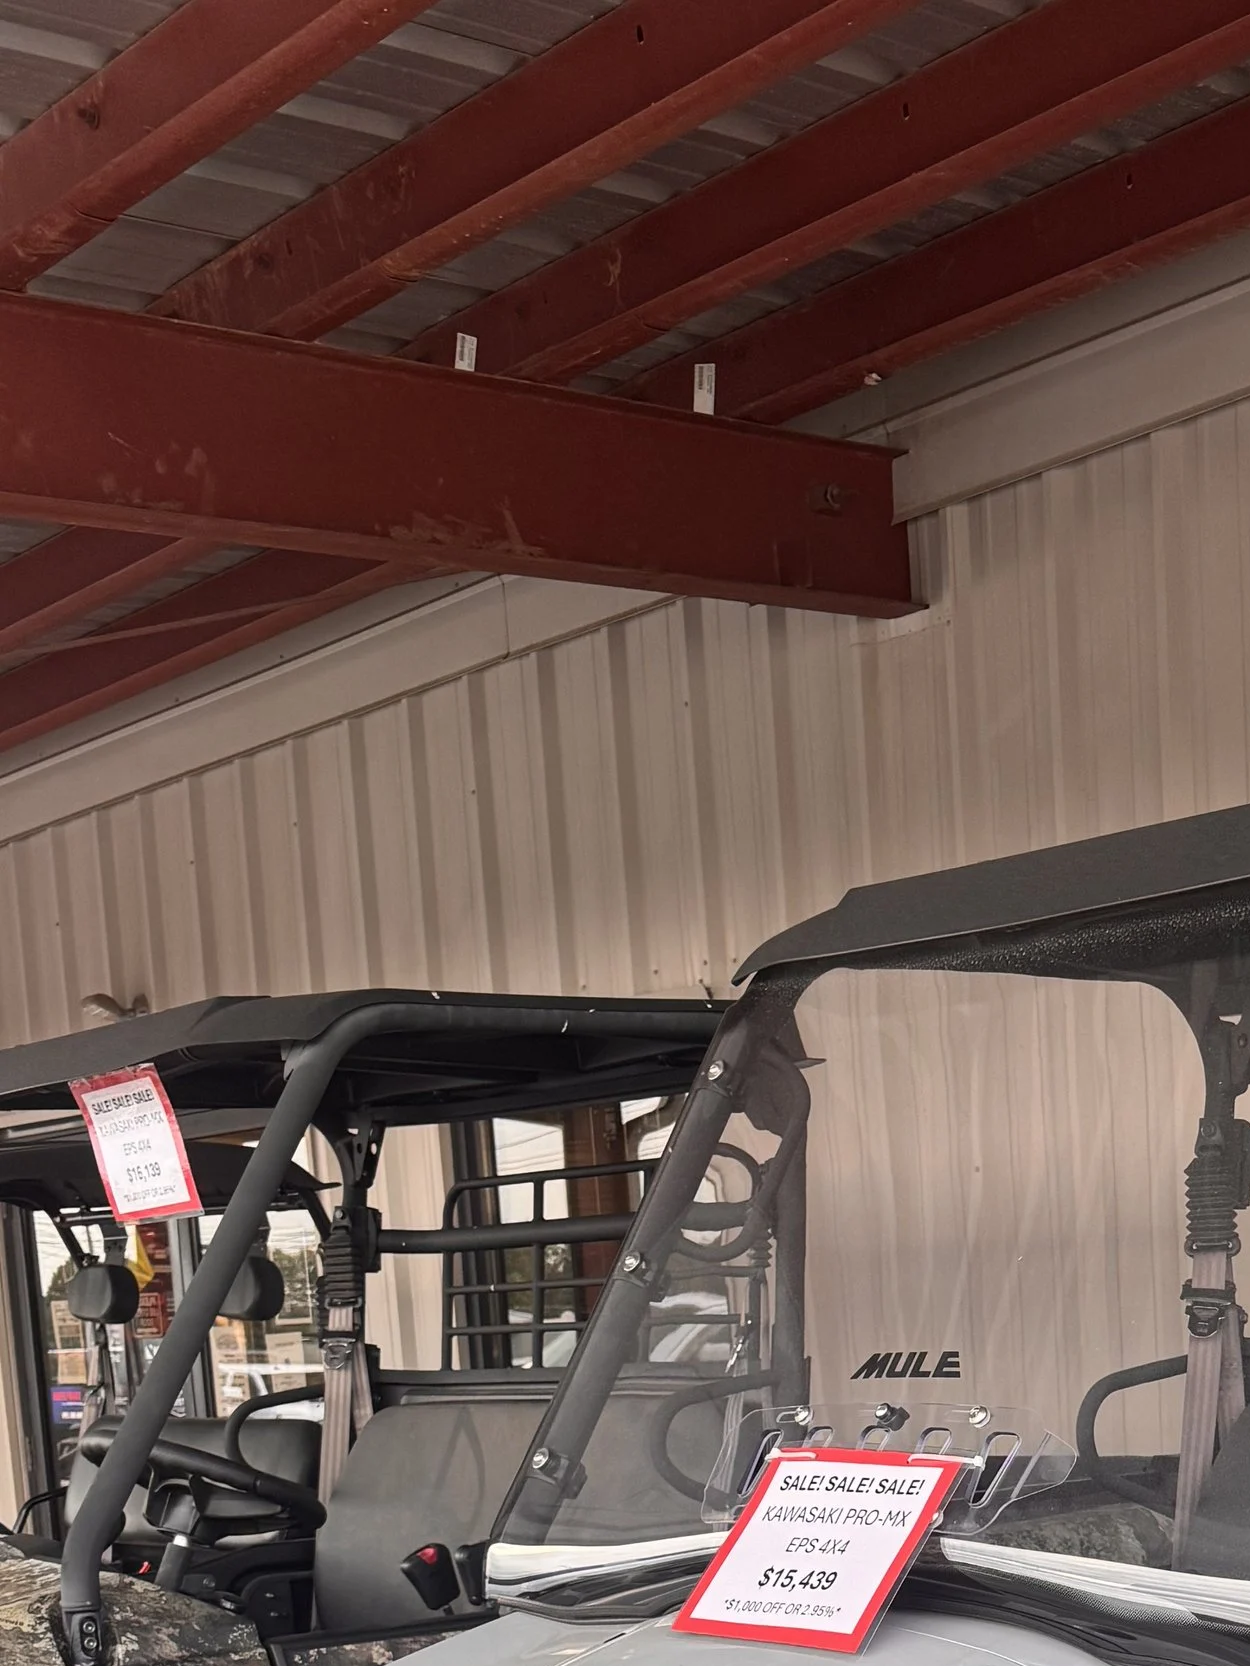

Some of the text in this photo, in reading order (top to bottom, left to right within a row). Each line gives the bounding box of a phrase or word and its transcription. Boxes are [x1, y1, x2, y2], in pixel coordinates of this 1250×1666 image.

[92, 1088, 155, 1115] SALE! SALE! SALE!
[126, 1161, 161, 1182] $16,139
[850, 1351, 961, 1379] MULE
[779, 1475, 924, 1496] SALE! SALE! SALE!
[762, 1505, 912, 1527] KAWASAKI PRO-MX
[785, 1537, 851, 1555] EPS 4X4
[757, 1566, 837, 1591] $15,439
[762, 1601, 785, 1615] OFF
[784, 1602, 803, 1616] OR
